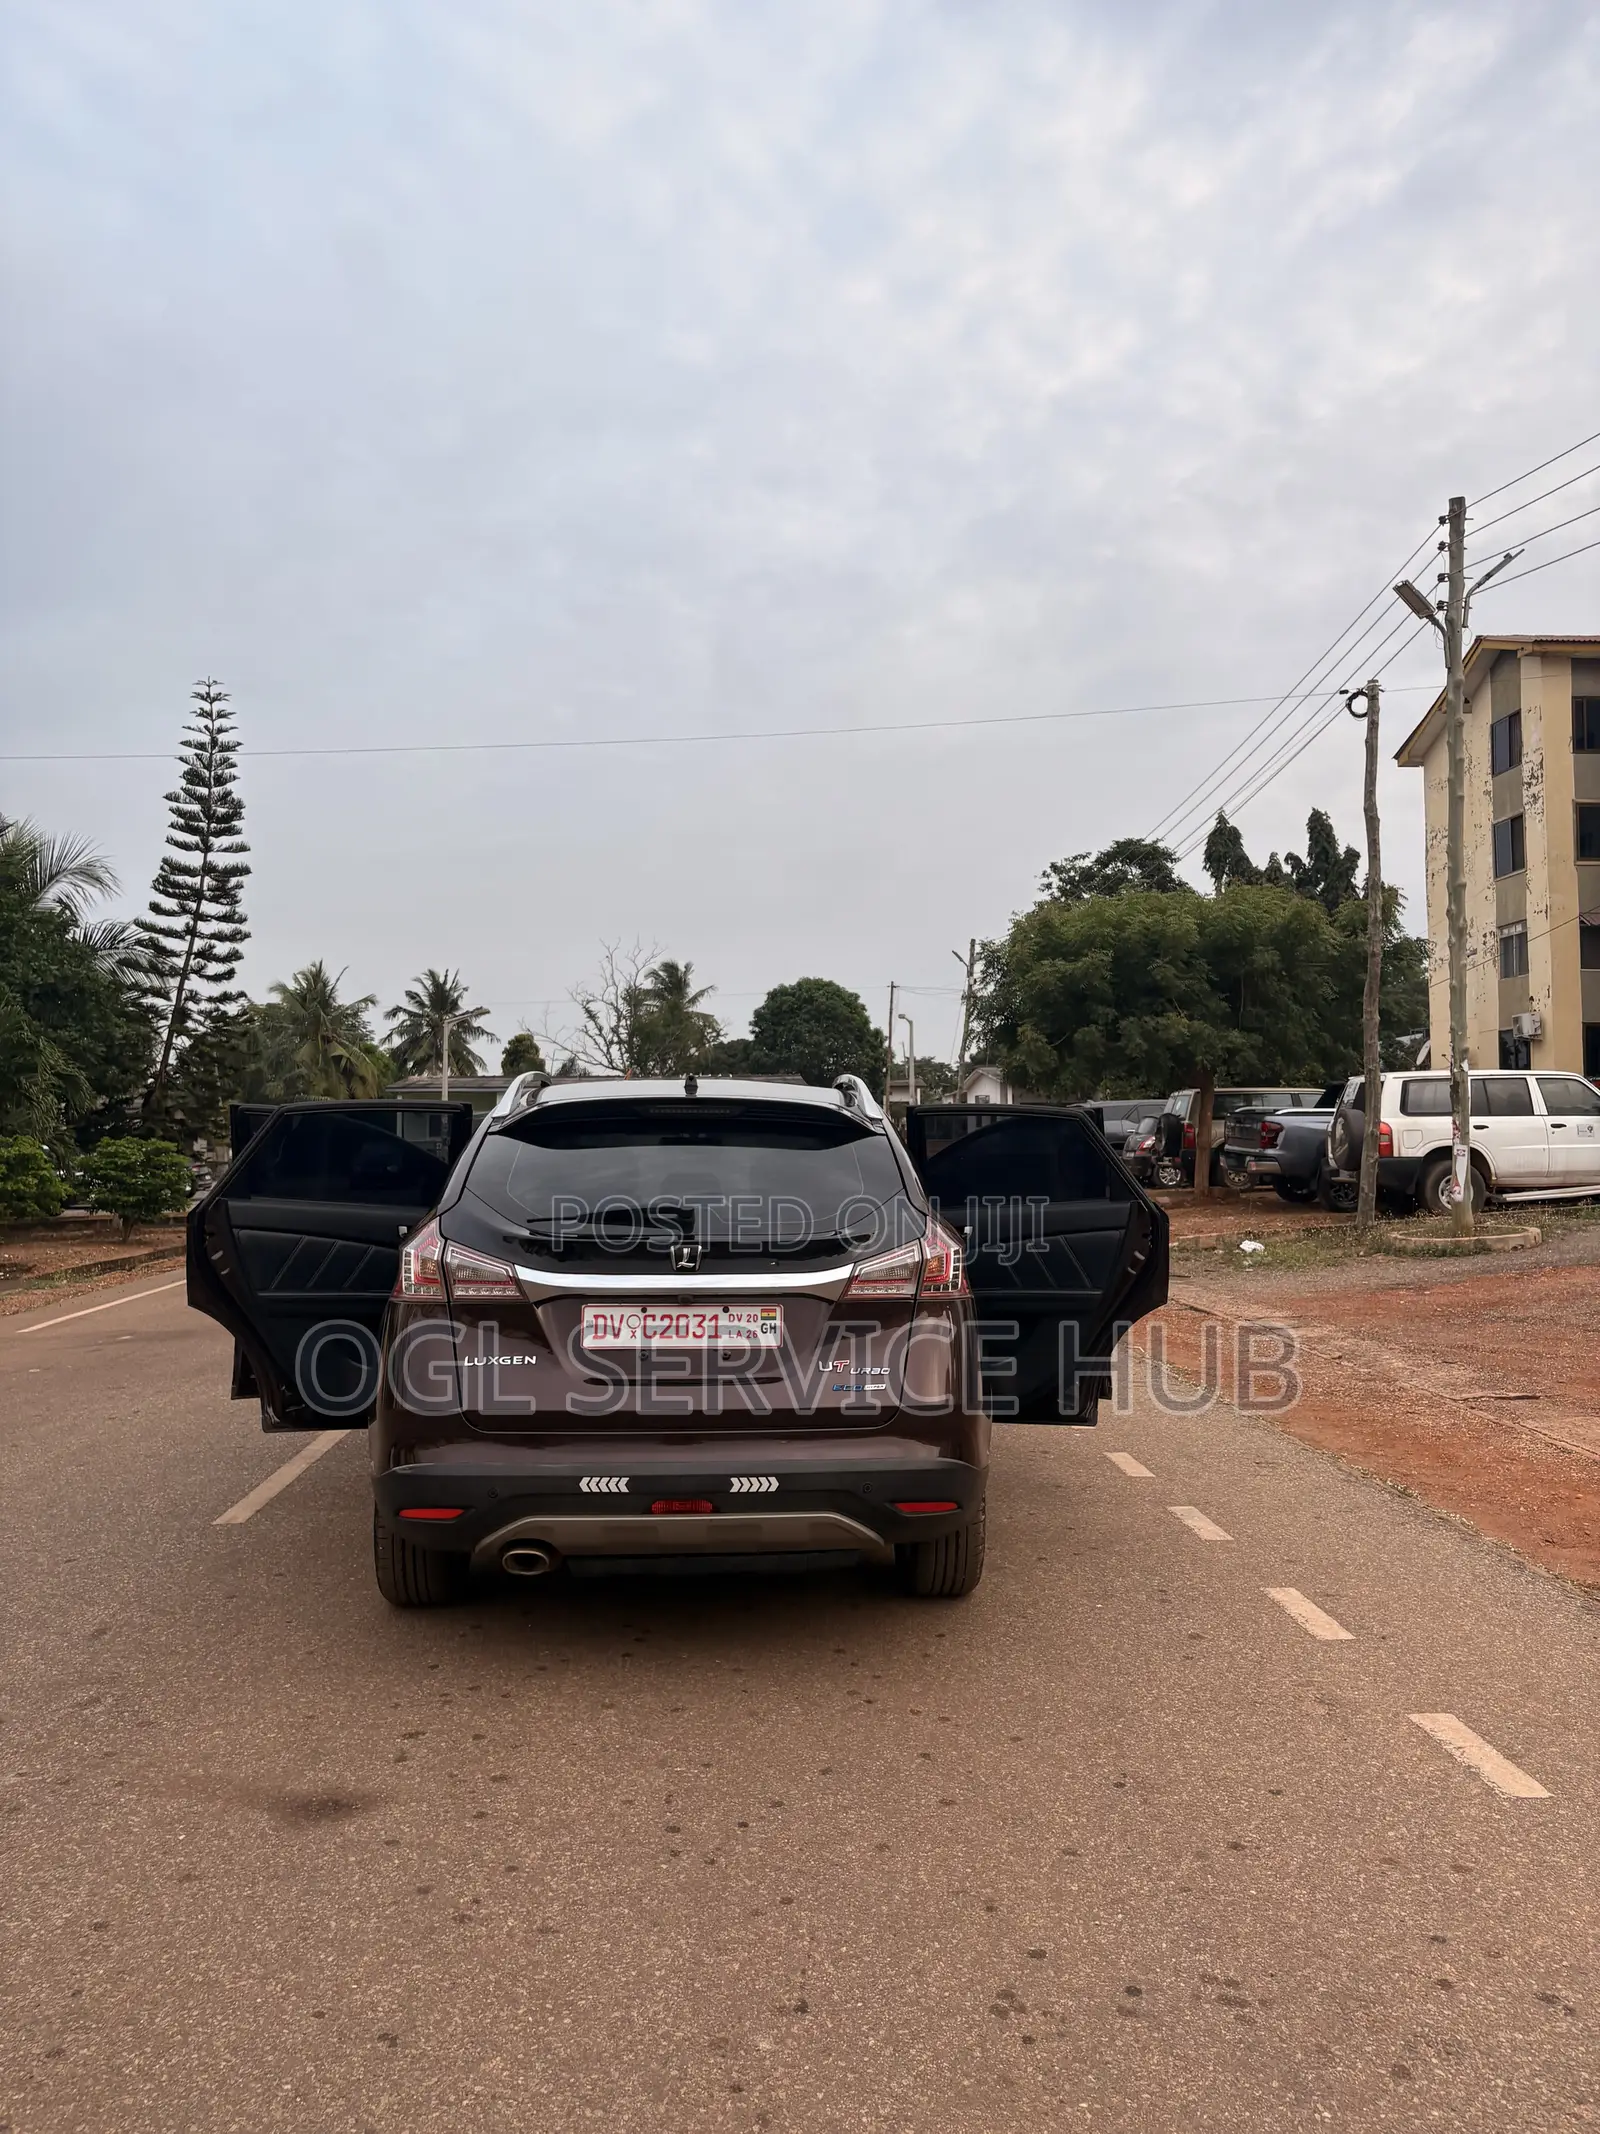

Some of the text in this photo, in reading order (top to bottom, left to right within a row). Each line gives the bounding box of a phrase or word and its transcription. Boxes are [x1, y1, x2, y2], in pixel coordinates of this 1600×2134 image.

[728, 1313, 758, 1323] DV 20
[592, 1313, 625, 1340] DV
[642, 1313, 722, 1340] C2031
[760, 1322, 777, 1335] GH
[728, 1329, 758, 1339] LA 26
[464, 1355, 537, 1366] LUXGEN
